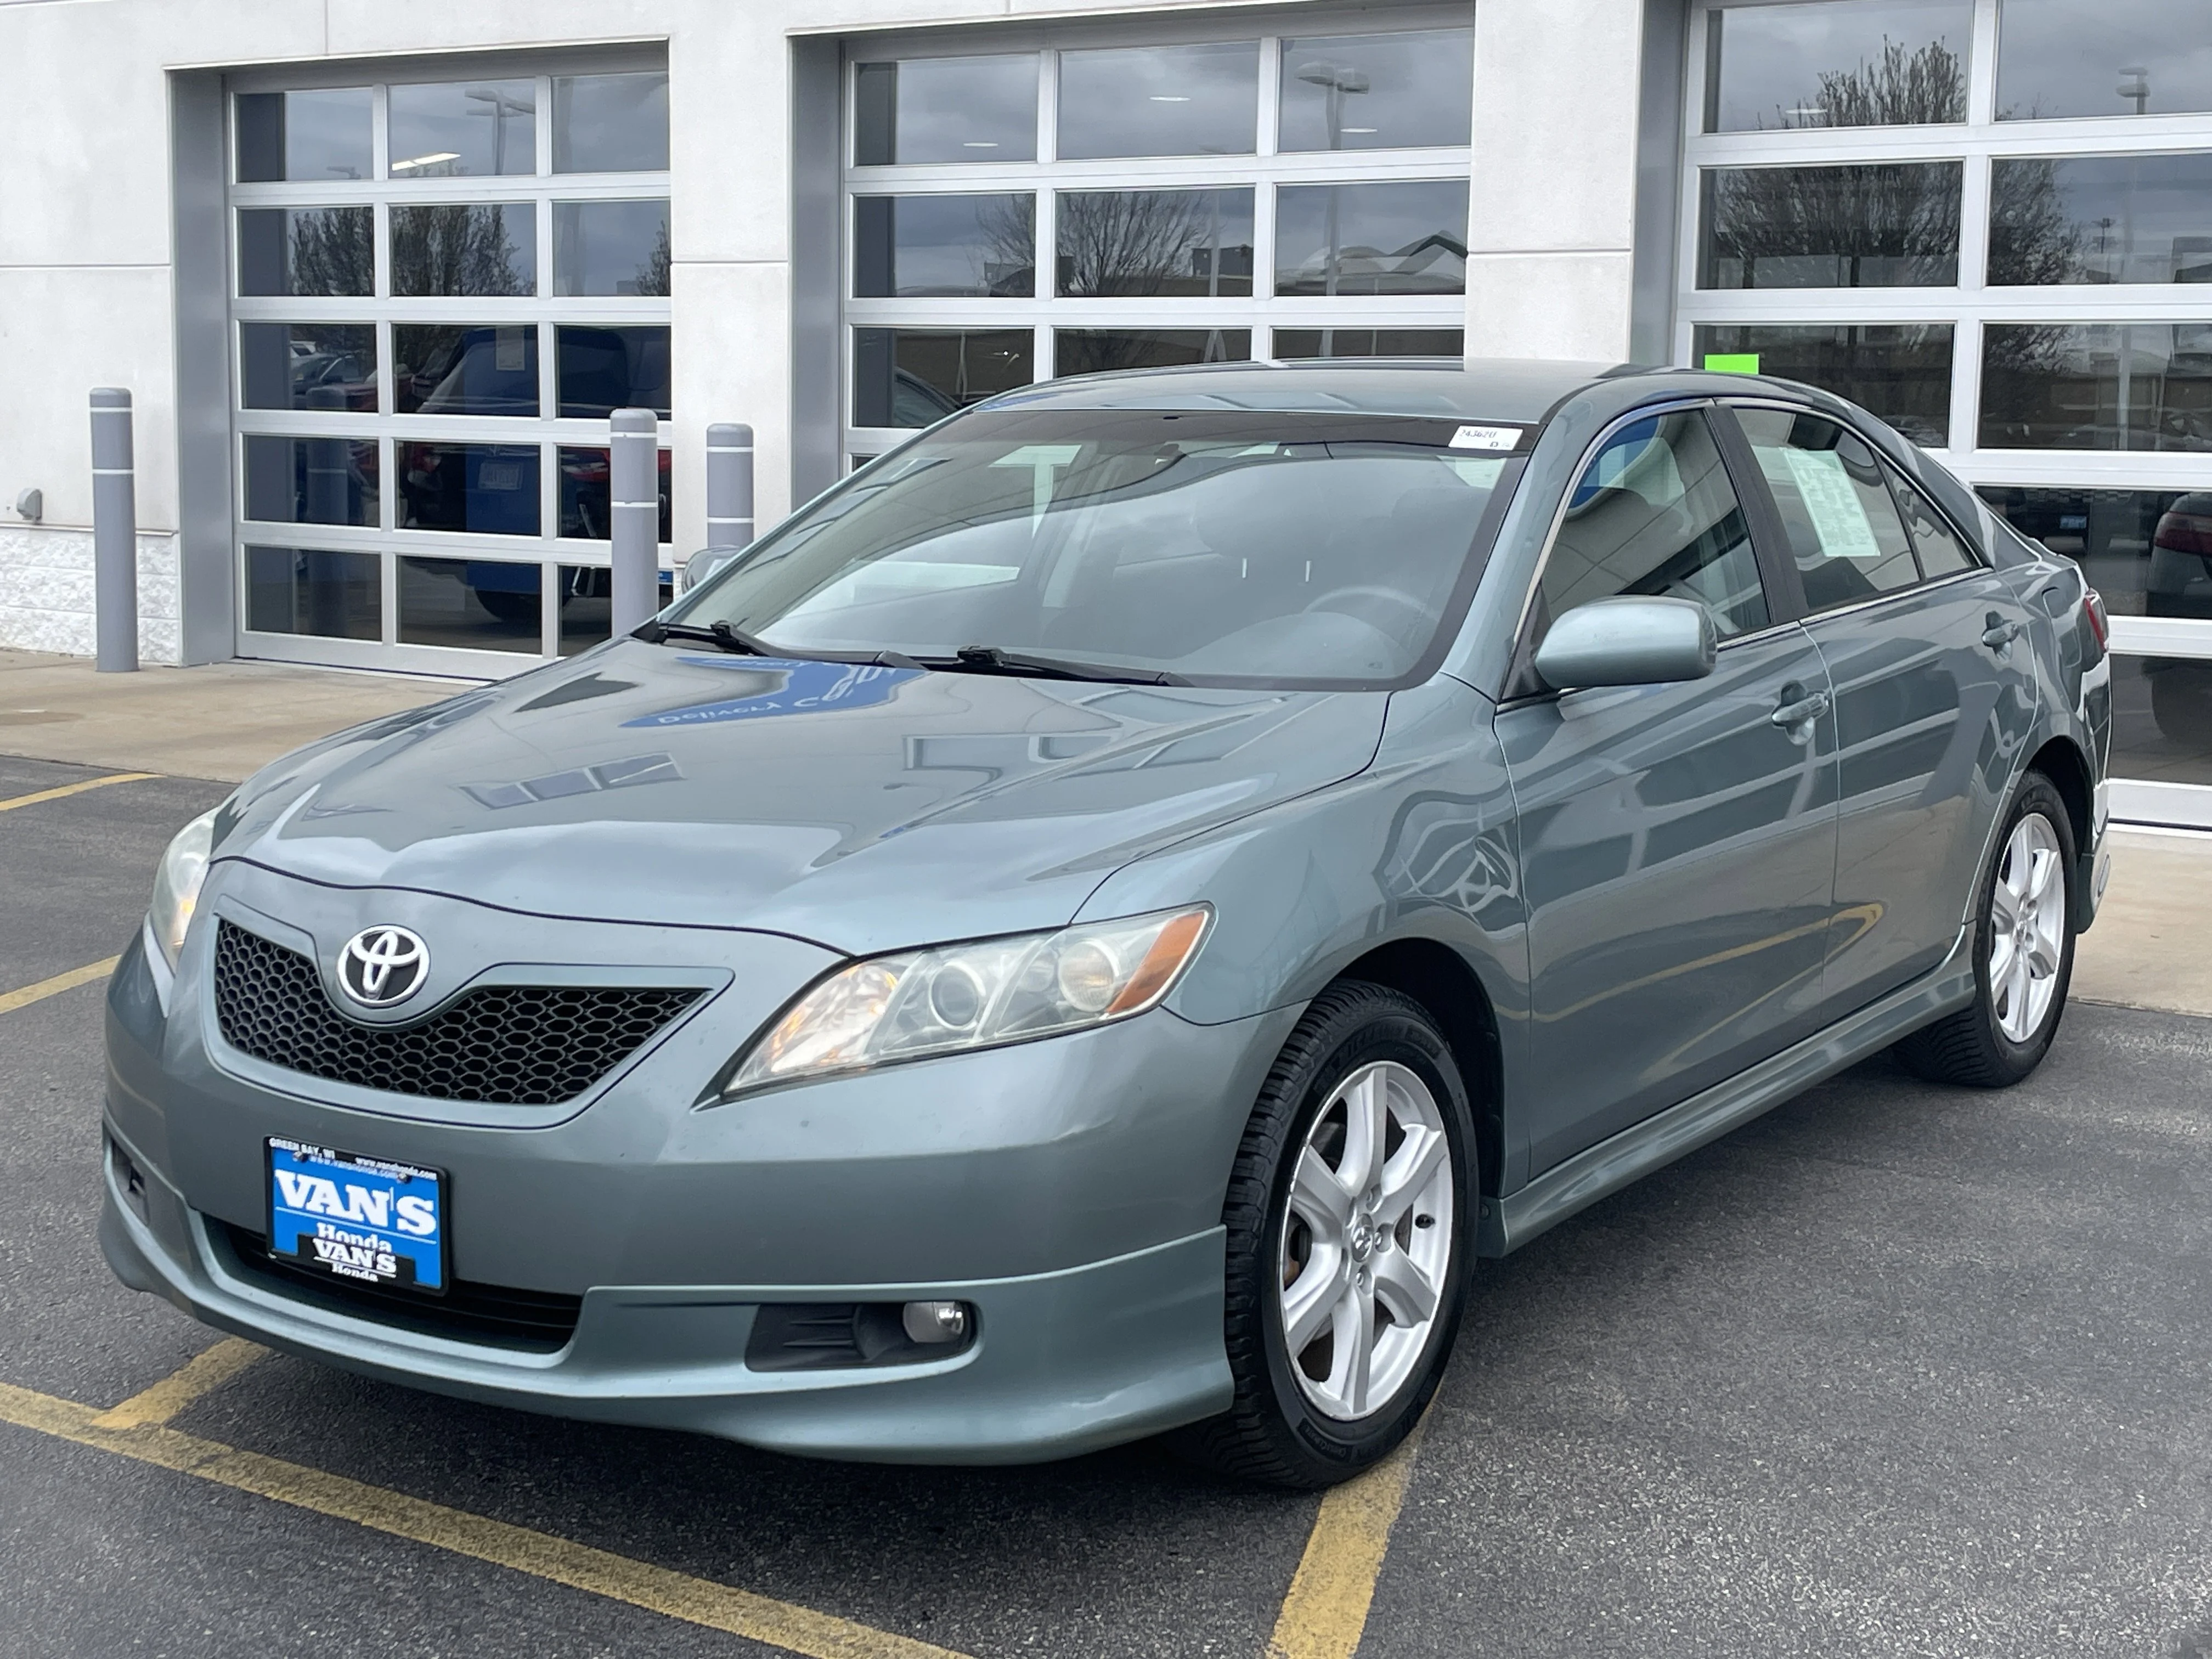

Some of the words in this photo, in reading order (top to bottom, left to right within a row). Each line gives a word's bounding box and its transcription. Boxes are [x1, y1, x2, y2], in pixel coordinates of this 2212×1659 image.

[269, 1137, 300, 1151] GREEN
[275, 1169, 437, 1235] VAN'S
[317, 1222, 392, 1253] Honda
[313, 1238, 397, 1273] VAN'S
[331, 1262, 379, 1282] Honda
